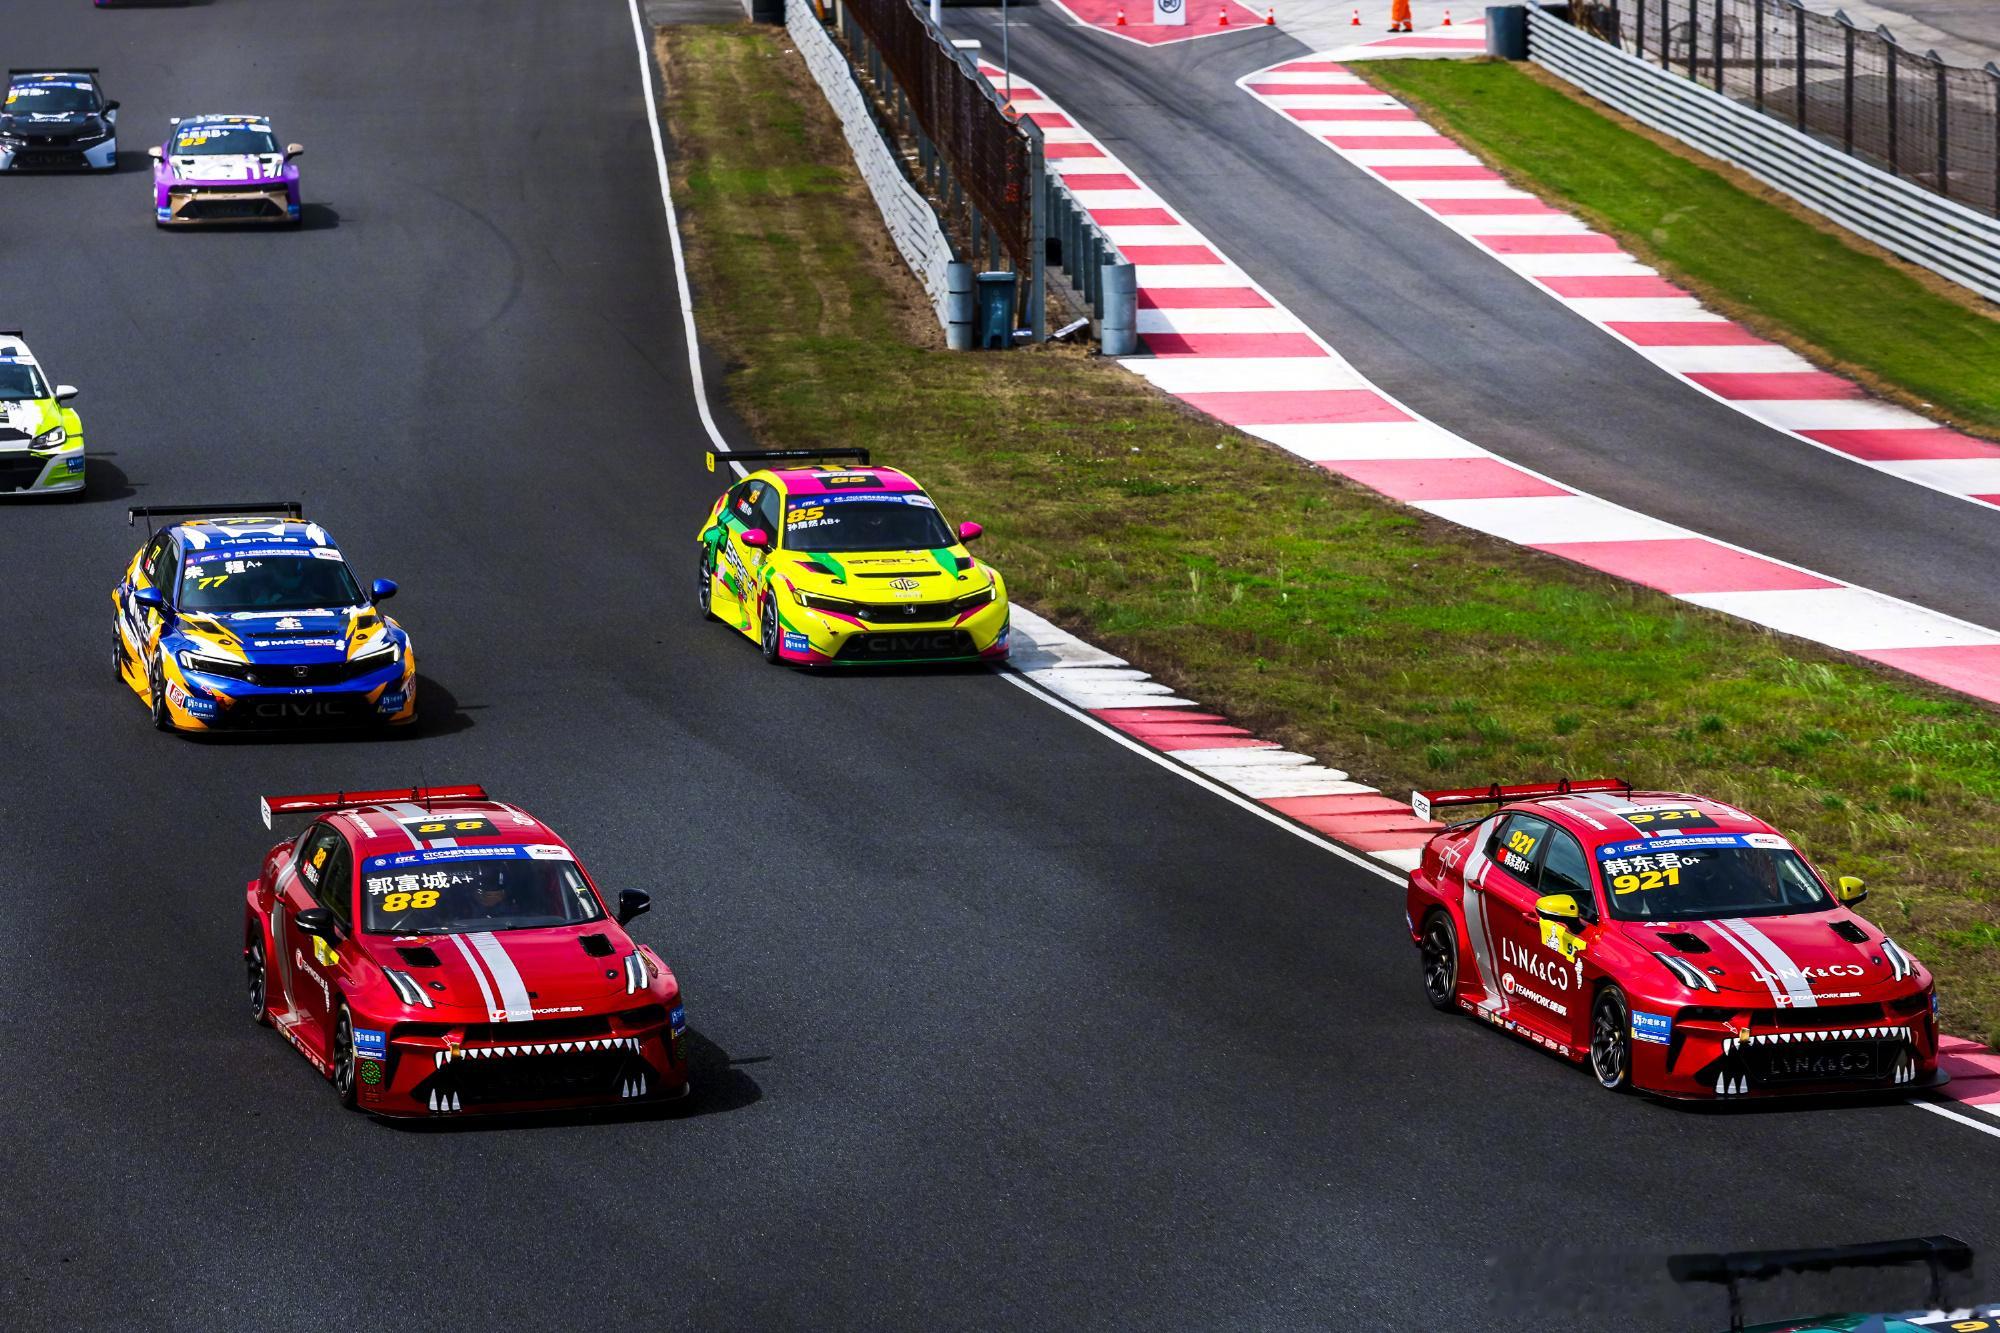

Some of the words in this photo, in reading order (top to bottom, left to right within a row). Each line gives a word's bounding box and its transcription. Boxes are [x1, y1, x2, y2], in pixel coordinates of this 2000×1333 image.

[787, 506, 825, 524] 85
[220, 536, 299, 546] Honda
[198, 575, 229, 590] 77
[868, 634, 952, 652] CIVIC
[255, 703, 346, 718] CIVIC
[1508, 831, 1536, 856] 921
[1603, 853, 1683, 877] 韩东君
[367, 872, 451, 896] 郭富城
[451, 875, 475, 885] A+
[1612, 868, 1681, 895] 921
[382, 890, 441, 912] 88
[1515, 983, 1551, 1010] TEAMWORK
[1794, 993, 1840, 1001] TEAMWORK
[510, 1007, 560, 1016] TEAMWORK
